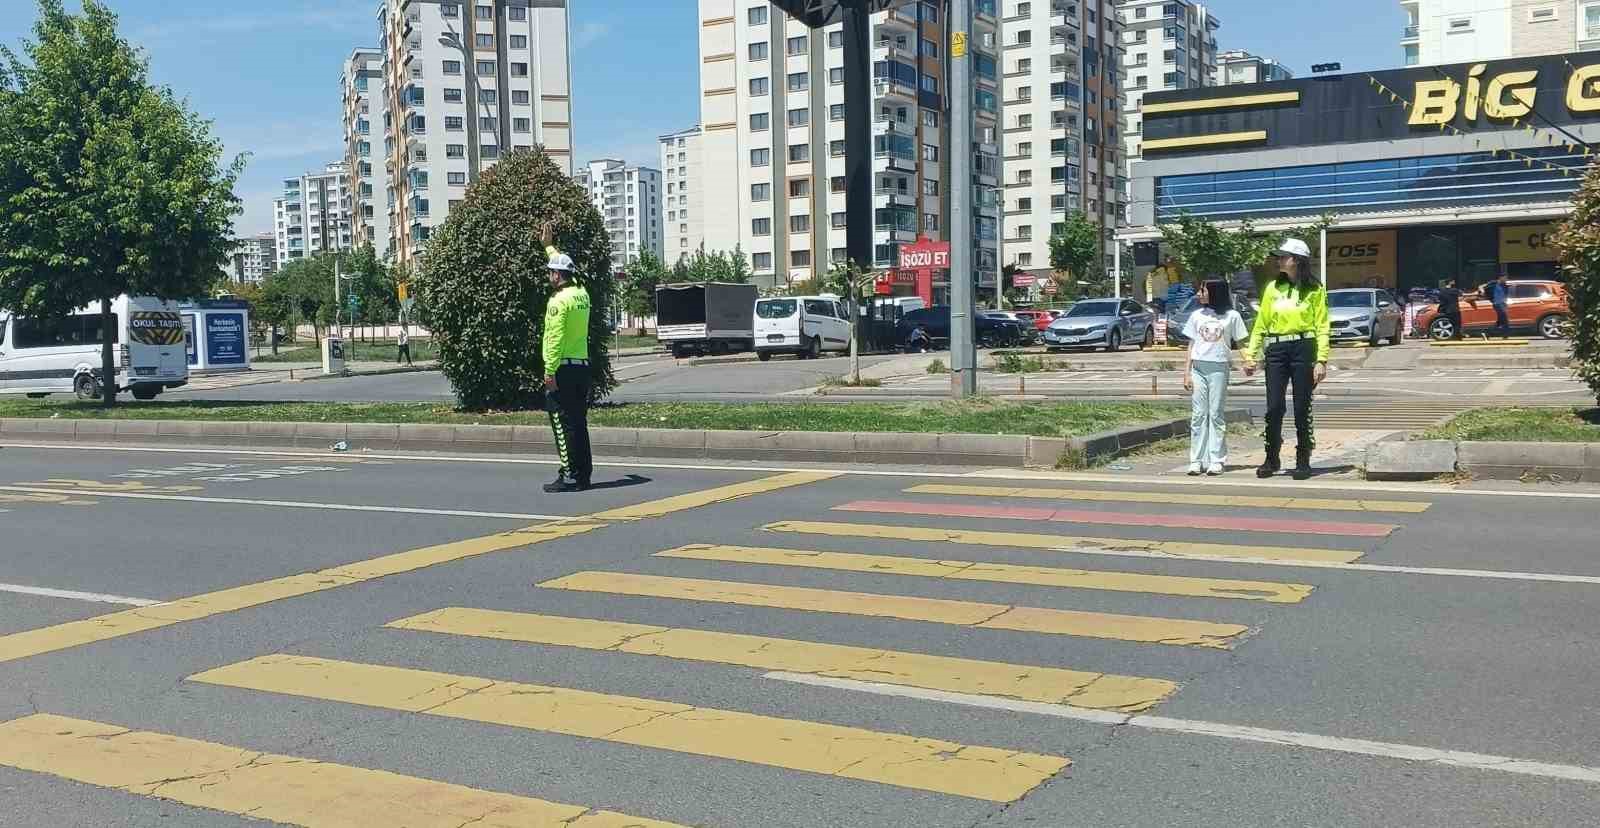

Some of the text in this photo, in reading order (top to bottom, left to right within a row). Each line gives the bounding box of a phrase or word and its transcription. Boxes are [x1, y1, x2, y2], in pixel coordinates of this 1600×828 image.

[1407, 64, 1538, 125] BİG
[900, 249, 948, 269] İŞÖZÜ ET
[133, 319, 156, 328] OKUL
